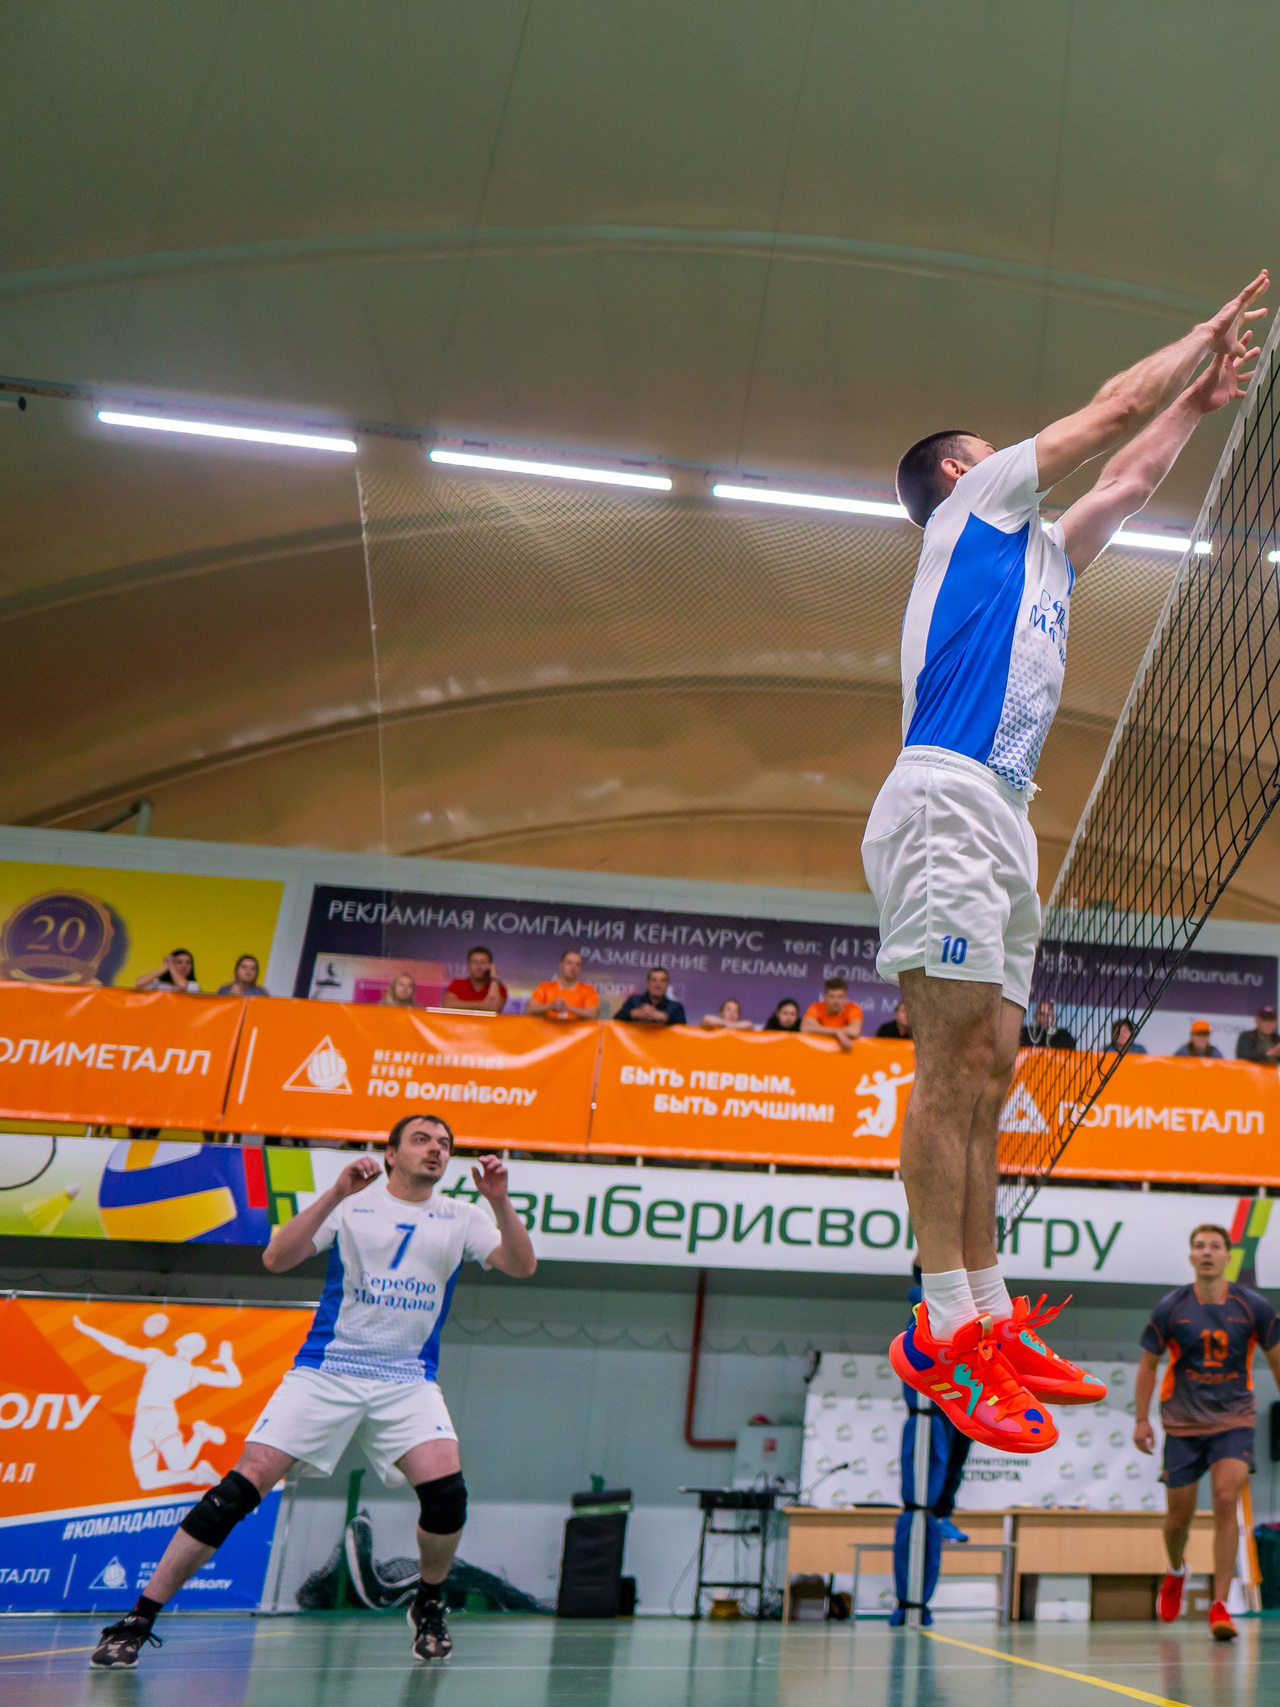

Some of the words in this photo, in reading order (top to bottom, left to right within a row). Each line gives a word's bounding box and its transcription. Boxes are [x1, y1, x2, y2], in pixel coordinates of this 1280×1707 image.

[26, 914, 86, 953] 20
[328, 900, 474, 930] РЕКЛАМНАЯ
[483, 911, 625, 943] КОМПАНИЯ
[633, 922, 764, 951] КЕНТАУРУС
[830, 937, 880, 960] (413
[940, 934, 969, 965] 10
[721, 956, 808, 979] РЕКЛАМЫ
[367, 1078, 400, 1098] ПО
[404, 1081, 538, 1107] ВОЛЕЙБОЛУ
[620, 1065, 685, 1088] БЫТЬ
[690, 1070, 796, 1097] ПЕРВЫМ,
[653, 1093, 719, 1117] БЫТЬ
[722, 1098, 835, 1123] ЛУЧШИМ!
[1057, 1101, 1265, 1135] ПОЛИМЕТАЛЛ
[388, 1222, 417, 1270] 7
[360, 1270, 436, 1296] Серебро
[1200, 1328, 1229, 1361] 13
[0, 1392, 102, 1431] ОЛУ
